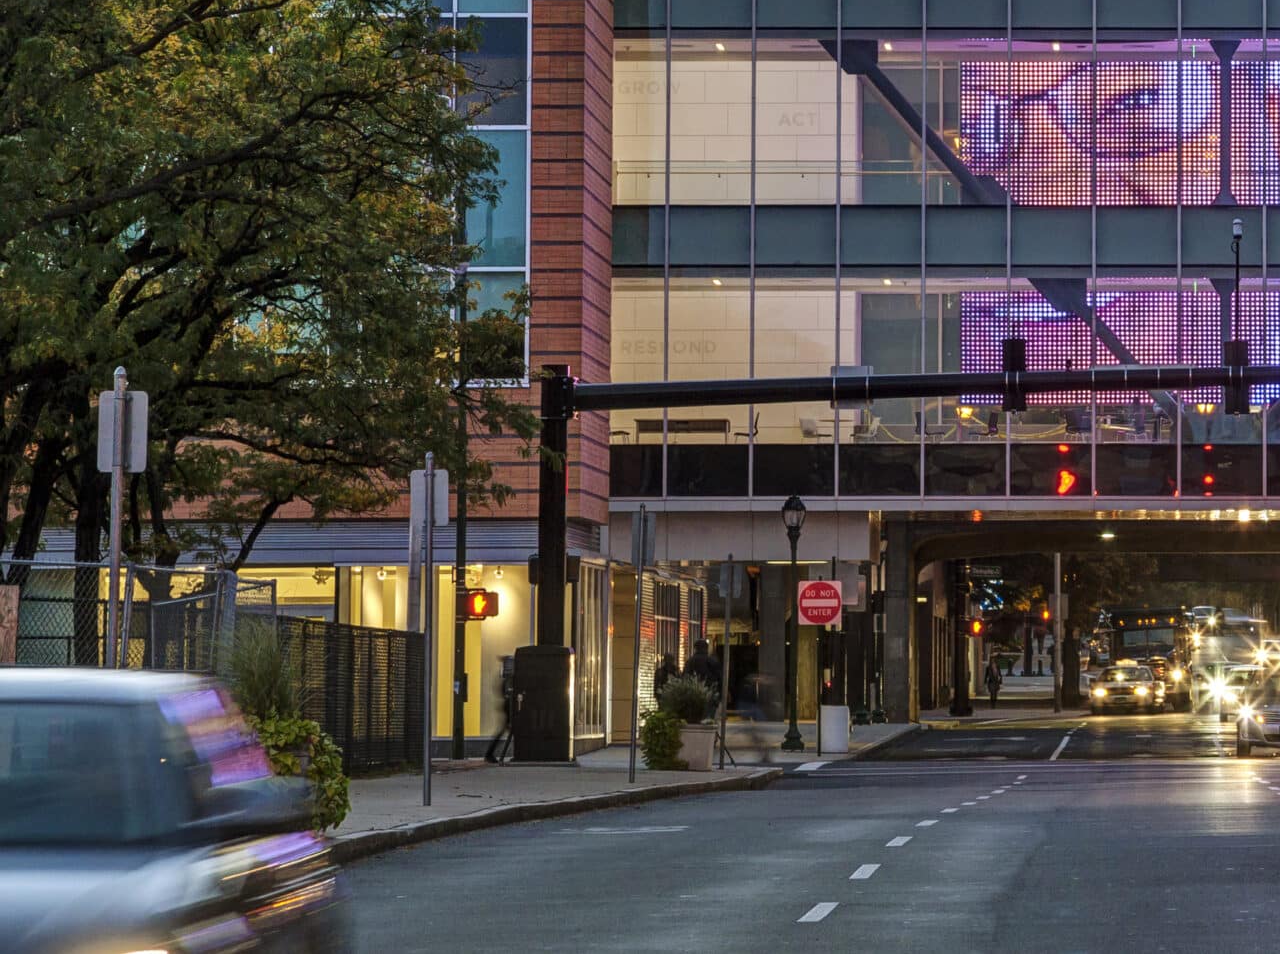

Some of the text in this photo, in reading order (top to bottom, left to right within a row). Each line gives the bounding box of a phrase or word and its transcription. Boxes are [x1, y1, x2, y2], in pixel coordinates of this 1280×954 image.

[778, 110, 817, 127] ACT
[805, 589, 835, 597] DO NOT
[807, 608, 832, 616] ENTER
